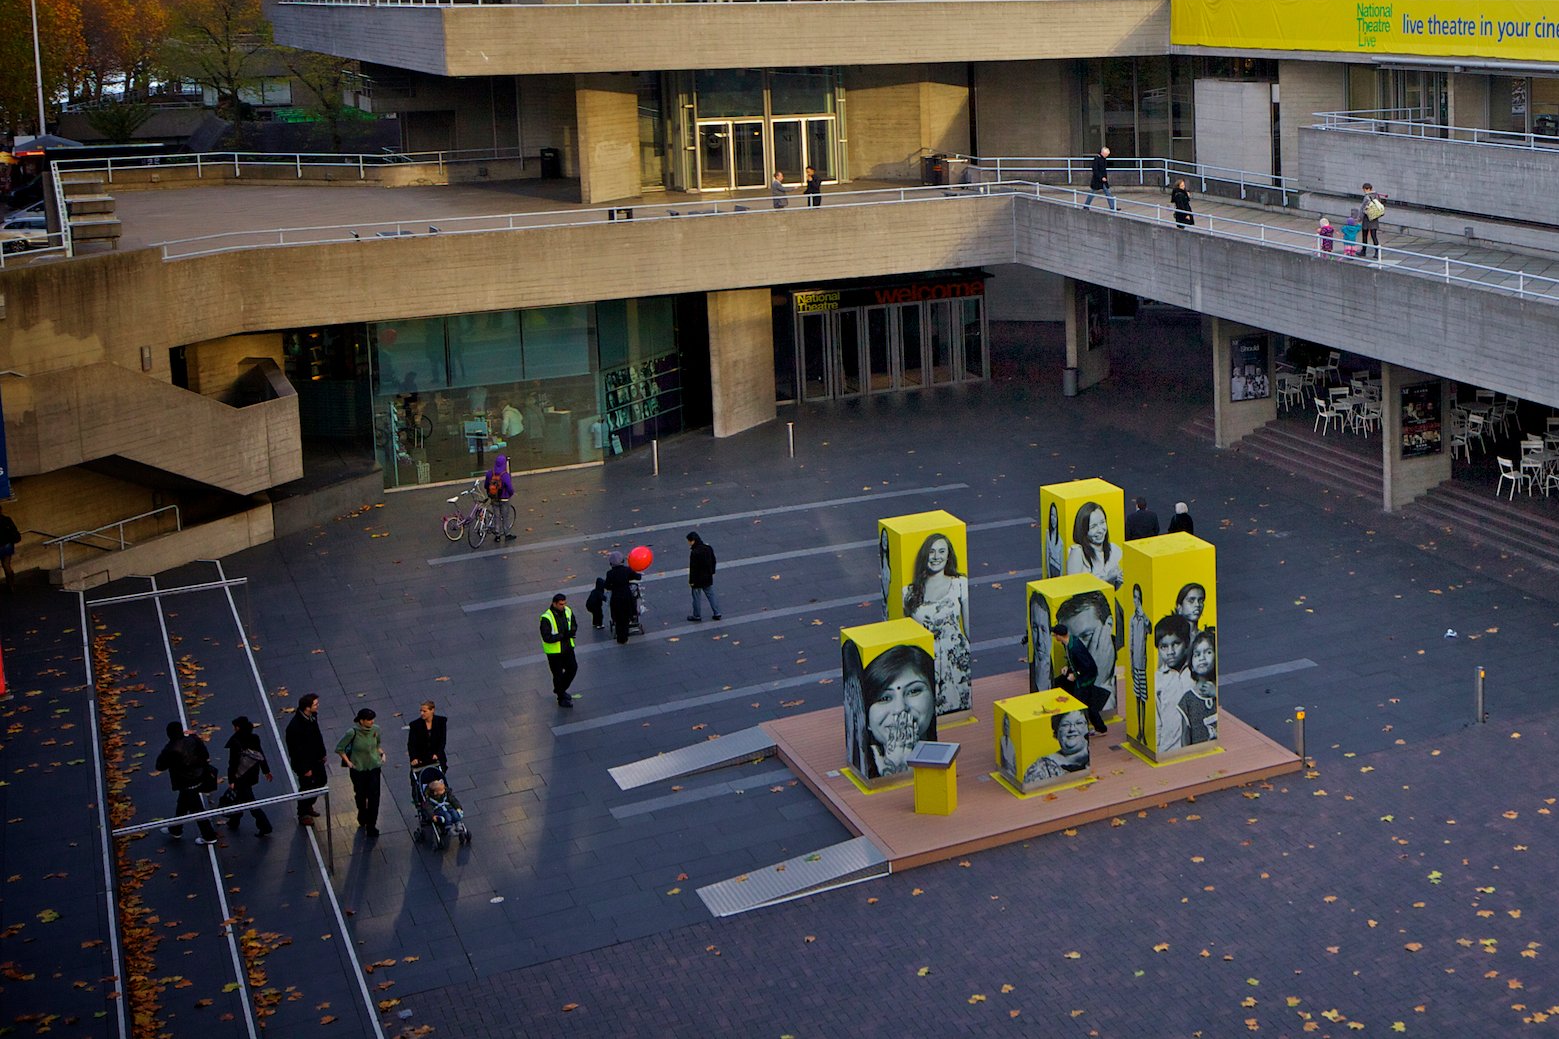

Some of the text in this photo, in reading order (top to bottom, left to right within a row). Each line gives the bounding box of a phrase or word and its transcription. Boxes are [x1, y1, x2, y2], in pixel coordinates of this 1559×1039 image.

[1356, 3, 1393, 18] National
[1356, 18, 1391, 33] Theatre
[1402, 13, 1424, 35] live
[1427, 14, 1476, 36] theatre
[1480, 15, 1493, 37] in
[1497, 19, 1531, 42] your
[1358, 31, 1377, 47] Live
[797, 292, 840, 304] National
[874, 280, 984, 305] welcome
[797, 302, 839, 313] Theatre
